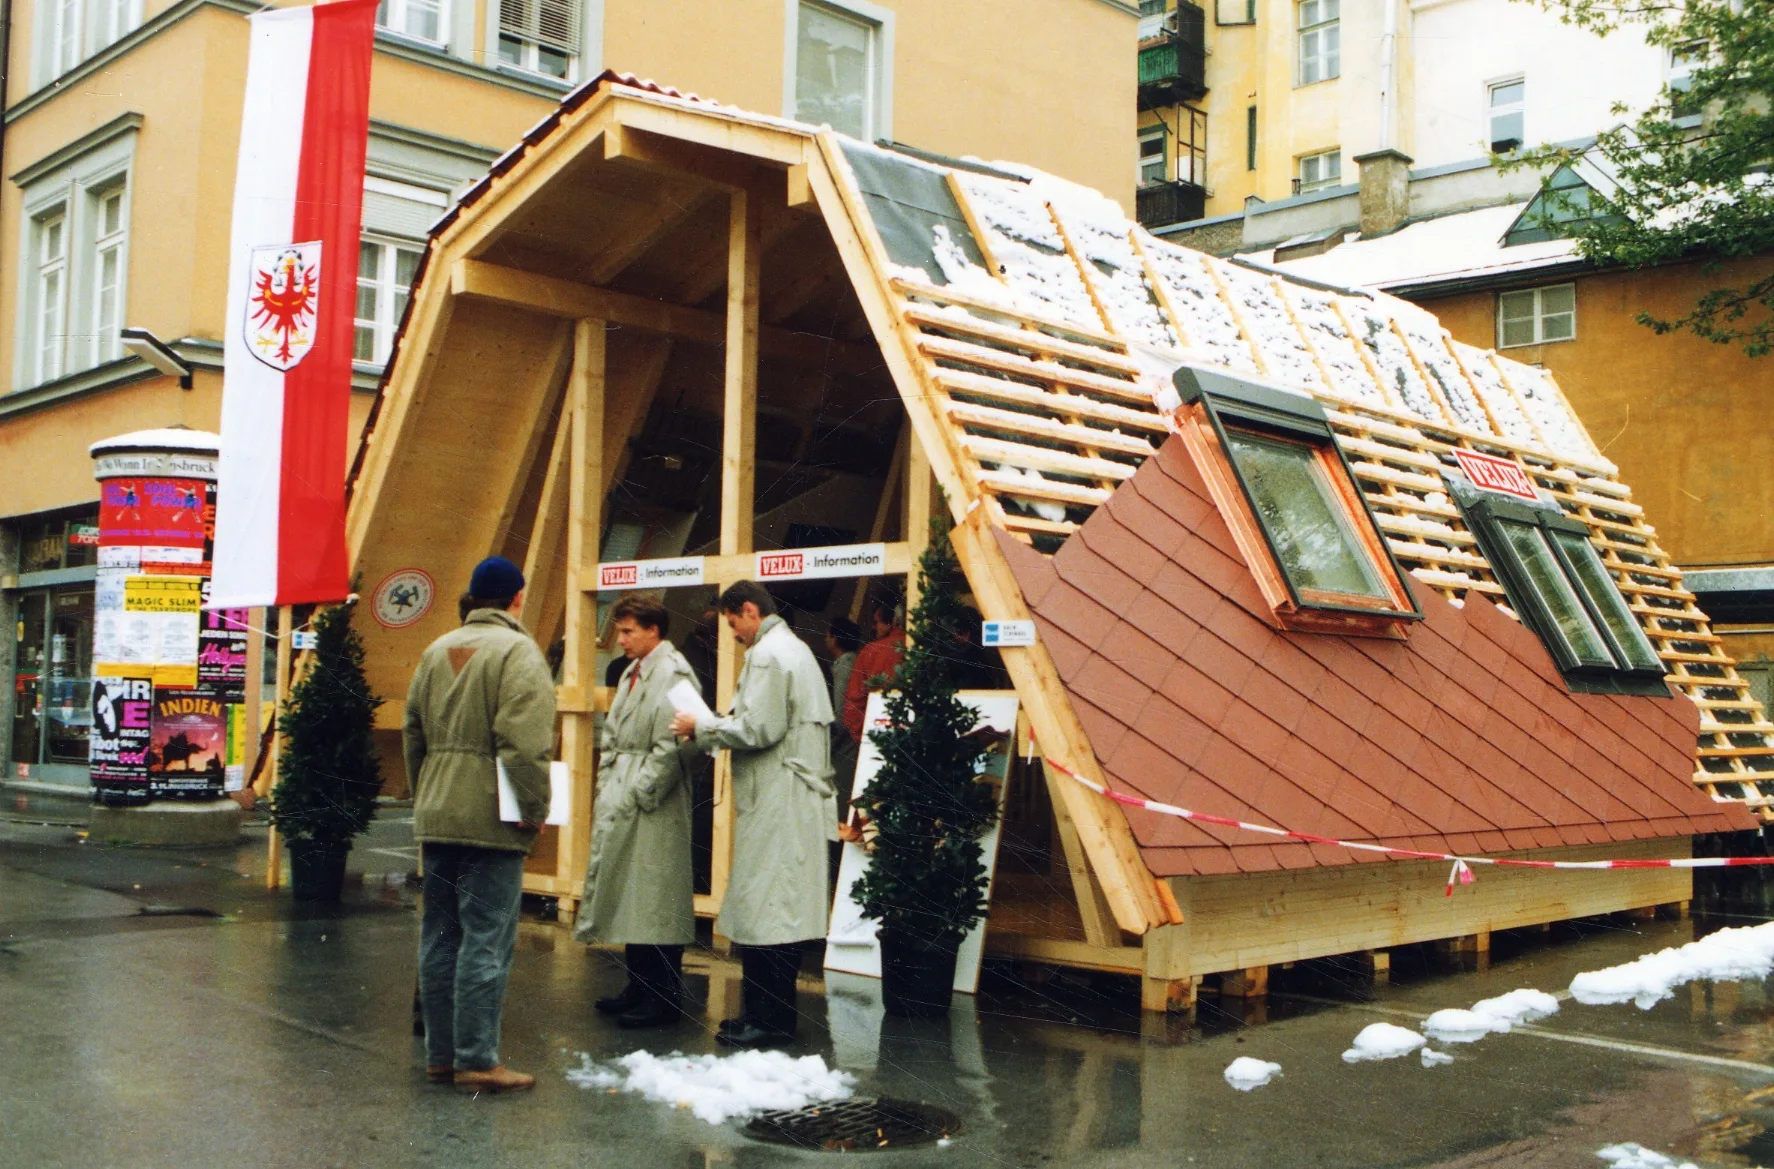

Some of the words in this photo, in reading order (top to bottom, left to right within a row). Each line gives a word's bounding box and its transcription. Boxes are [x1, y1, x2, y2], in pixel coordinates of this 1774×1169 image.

[1460, 455, 1534, 495] VELUX
[761, 555, 802, 575] VELUX
[814, 552, 879, 567] Information
[602, 566, 636, 584] VELUX
[646, 565, 699, 579] Information
[127, 597, 163, 606] MAGIC
[169, 598, 197, 607] SLIM
[160, 698, 222, 717] INDIEN
